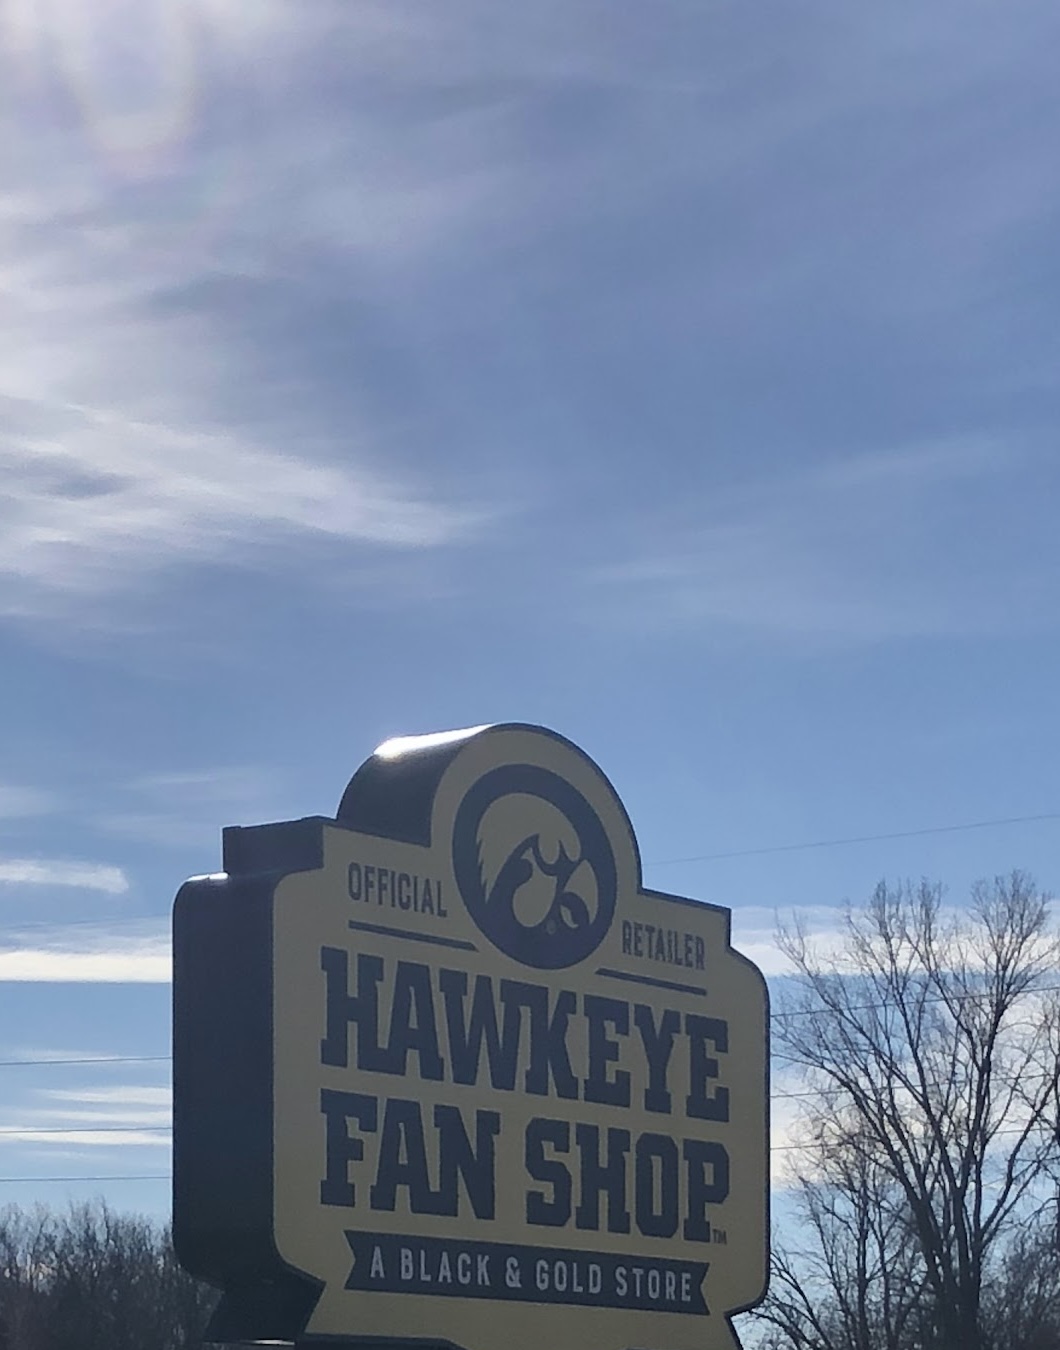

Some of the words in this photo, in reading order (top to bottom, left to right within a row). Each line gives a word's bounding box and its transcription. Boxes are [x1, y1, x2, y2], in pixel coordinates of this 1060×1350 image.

[348, 862, 447, 917] OFFICIAL
[622, 920, 705, 970] RETAILER
[320, 946, 729, 1122] HAWKEYE
[320, 1088, 500, 1220] FAN
[525, 1117, 729, 1243] SHOP
[370, 1246, 385, 1278] A
[401, 1248, 490, 1287] BLACK
[505, 1257, 521, 1289] &
[535, 1258, 600, 1295] GOLD
[615, 1266, 692, 1302] STORE
